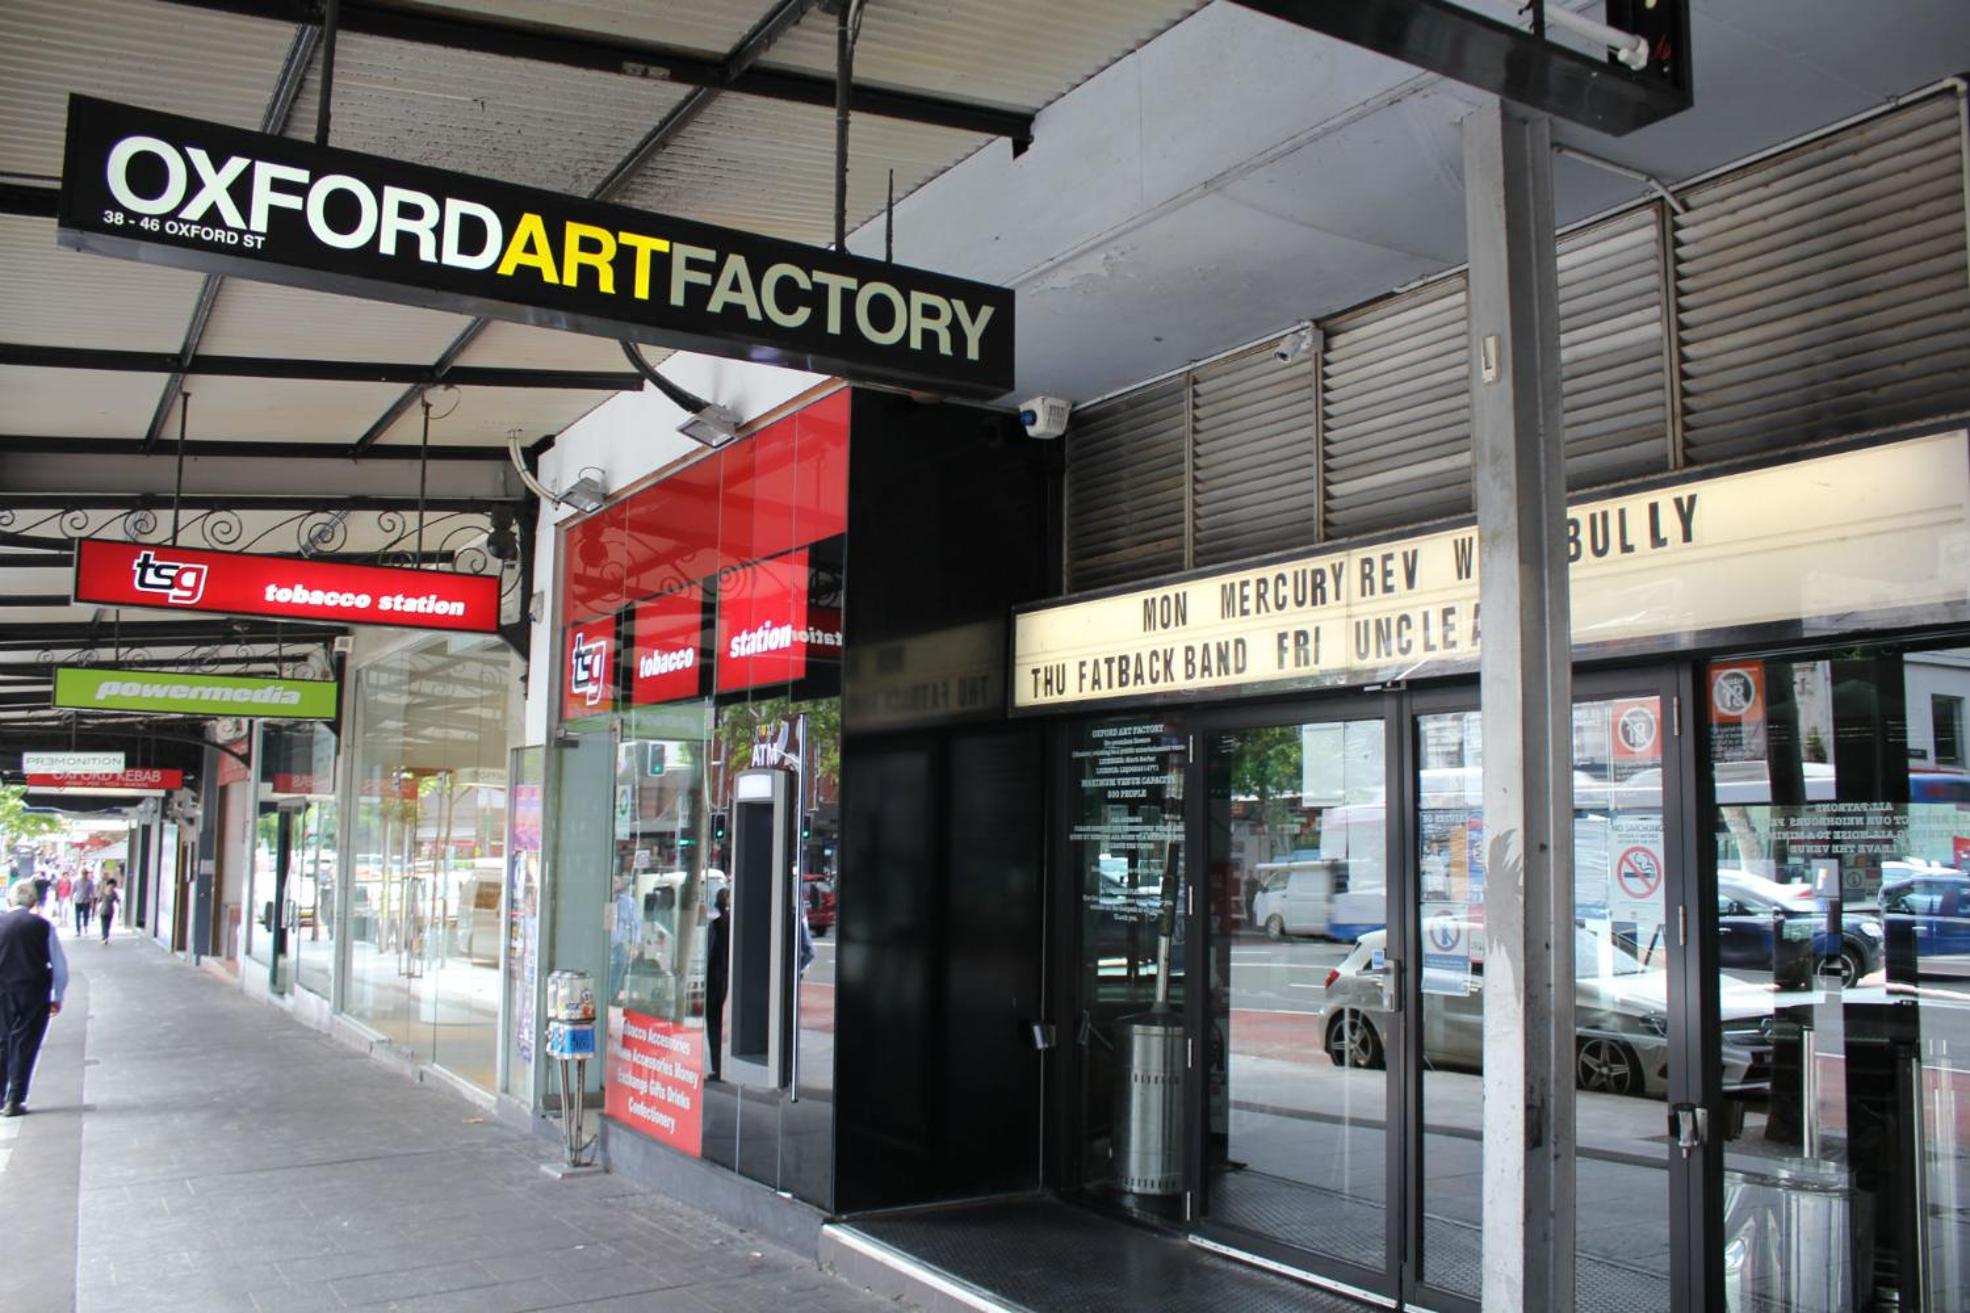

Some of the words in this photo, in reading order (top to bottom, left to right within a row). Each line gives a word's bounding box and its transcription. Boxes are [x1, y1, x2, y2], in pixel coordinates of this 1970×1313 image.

[103, 210, 124, 225] 38
[140, 217, 160, 232] 46
[164, 221, 239, 245] OXFORD
[242, 234, 266, 250] ST
[133, 551, 208, 604] tsg
[265, 584, 371, 608] tobacco
[379, 594, 465, 616] station
[1143, 592, 1187, 632] MON
[1221, 562, 1344, 620] MERCURY
[1360, 549, 1418, 598] REV
[572, 632, 606, 706] tsg
[640, 647, 694, 678] tobacco
[730, 619, 793, 658] station
[1031, 663, 1066, 699] THU
[1078, 647, 1175, 693] FATBACK
[1184, 637, 1247, 681] BAND
[1277, 626, 1320, 670] FRI
[1355, 606, 1457, 661] UNCLE
[96, 681, 300, 705] powermedia
[752, 743, 777, 767] ATM
[116, 770, 161, 782] KEBAB
[633, 1048, 673, 1077] Accessories
[628, 1096, 675, 1135] Confectionery
